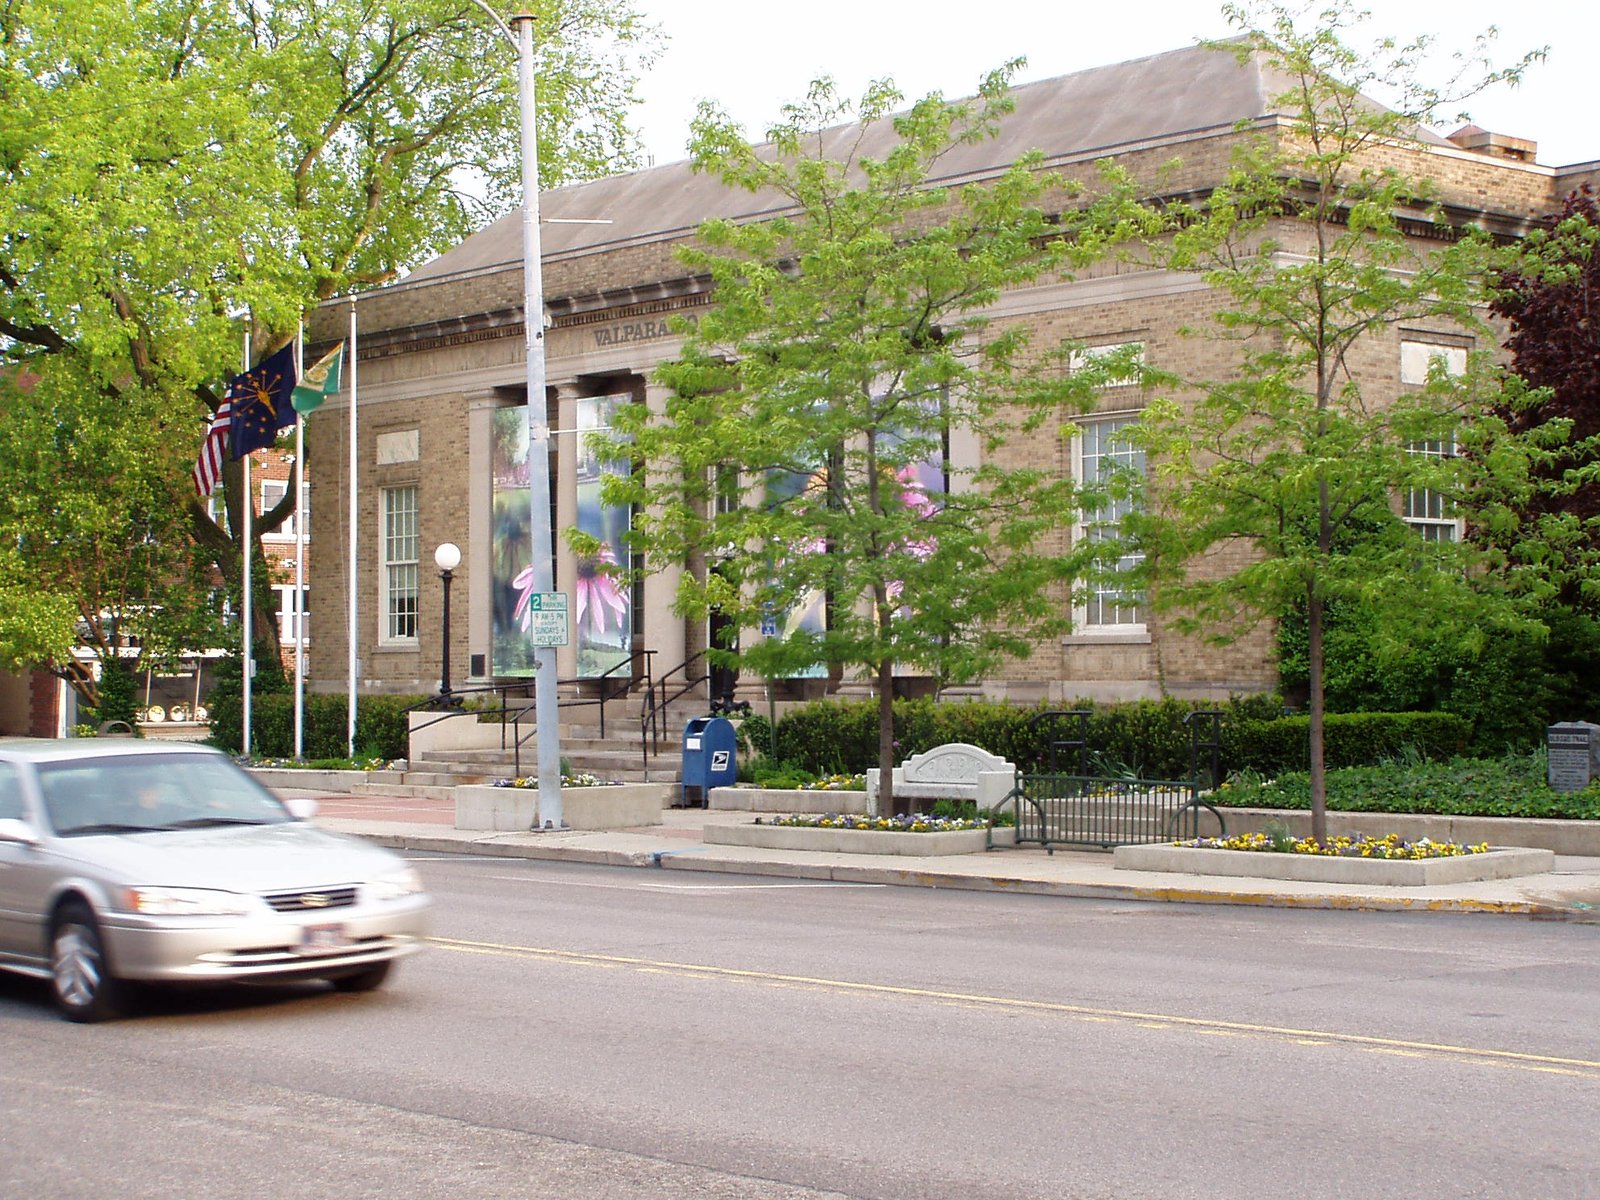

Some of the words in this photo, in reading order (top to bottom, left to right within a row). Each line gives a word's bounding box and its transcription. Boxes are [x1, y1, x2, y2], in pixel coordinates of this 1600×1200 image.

[594, 314, 698, 346] VALPARAO
[532, 596, 541, 609] 2
[535, 626, 559, 634] SUNDAYS
[537, 635, 563, 643] HOLIDAYS
